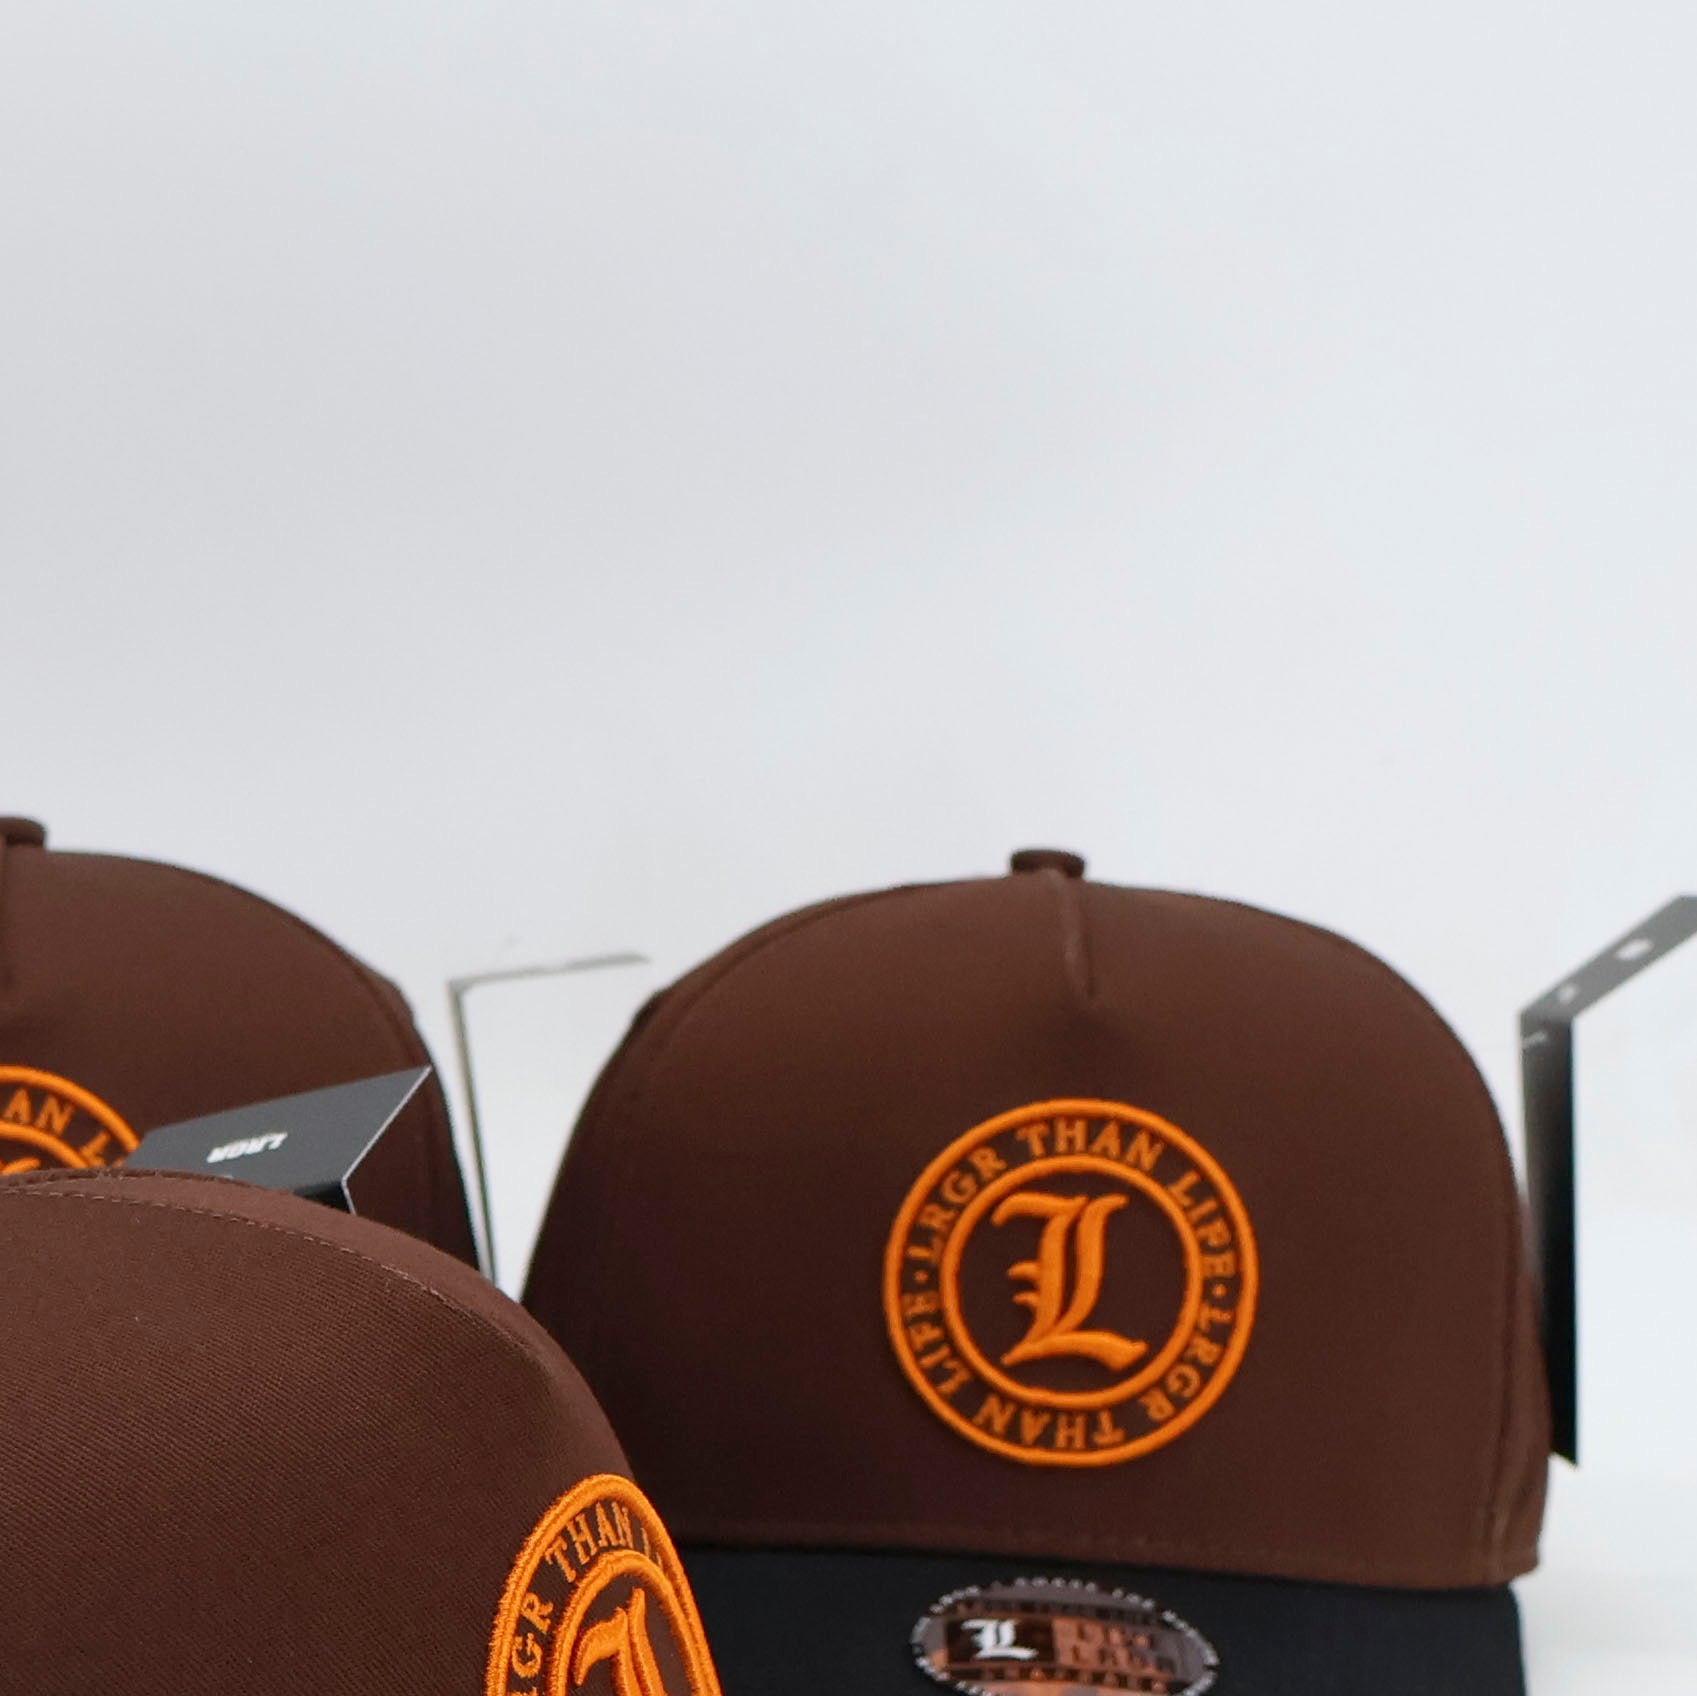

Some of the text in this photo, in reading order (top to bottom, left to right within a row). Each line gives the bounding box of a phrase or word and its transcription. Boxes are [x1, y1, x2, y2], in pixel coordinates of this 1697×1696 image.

[907, 1146, 1007, 1262] LRGR
[1015, 1116, 1167, 1173] THAN
[990, 1191, 1150, 1372] L
[971, 1395, 1126, 1449] THAN
[1137, 1302, 1232, 1422] LRGR
[544, 1500, 634, 1585] THAN
